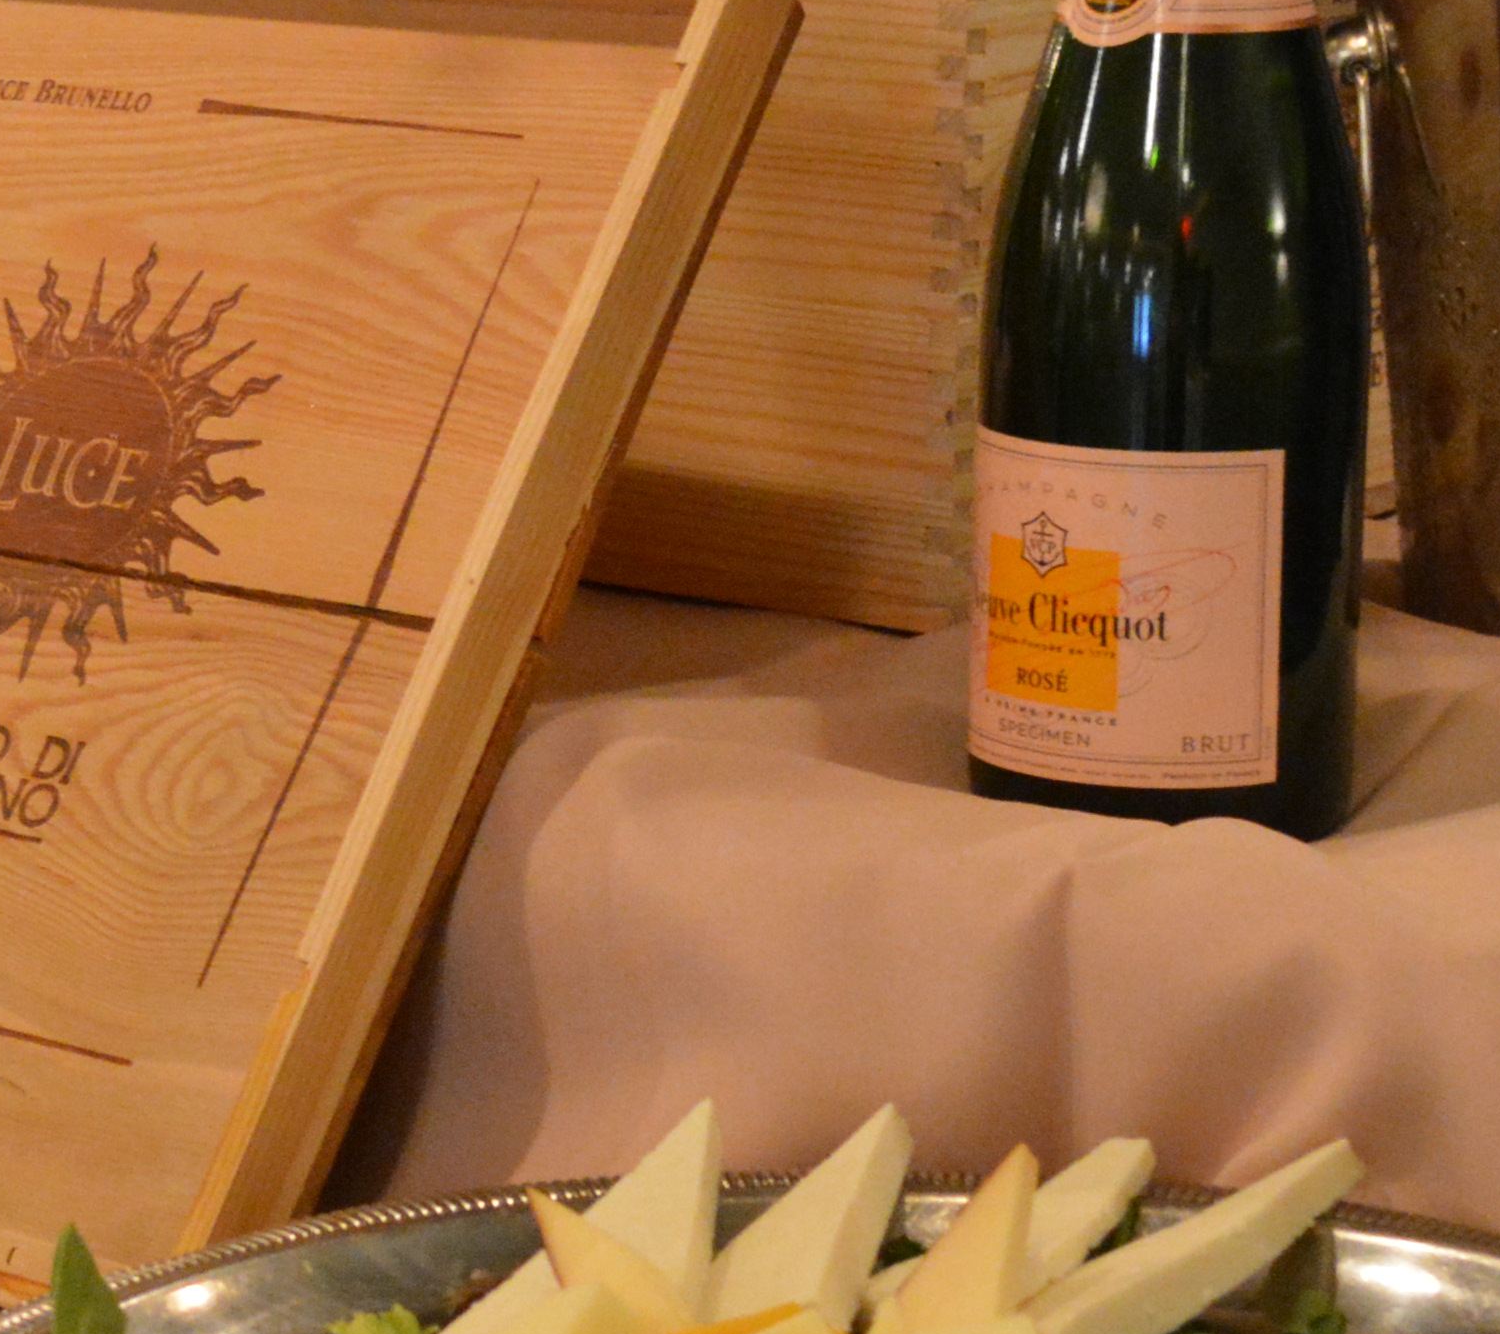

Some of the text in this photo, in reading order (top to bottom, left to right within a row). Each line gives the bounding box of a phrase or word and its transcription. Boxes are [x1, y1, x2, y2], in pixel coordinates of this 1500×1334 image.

[33, 78, 153, 114] BRUNELLO
[1029, 591, 1168, 647] Clicquot
[1017, 667, 1068, 693] ROSÉ
[998, 717, 1091, 748] SPECIMEN
[1181, 733, 1251, 754] BRUT
[31, 734, 87, 785] DI
